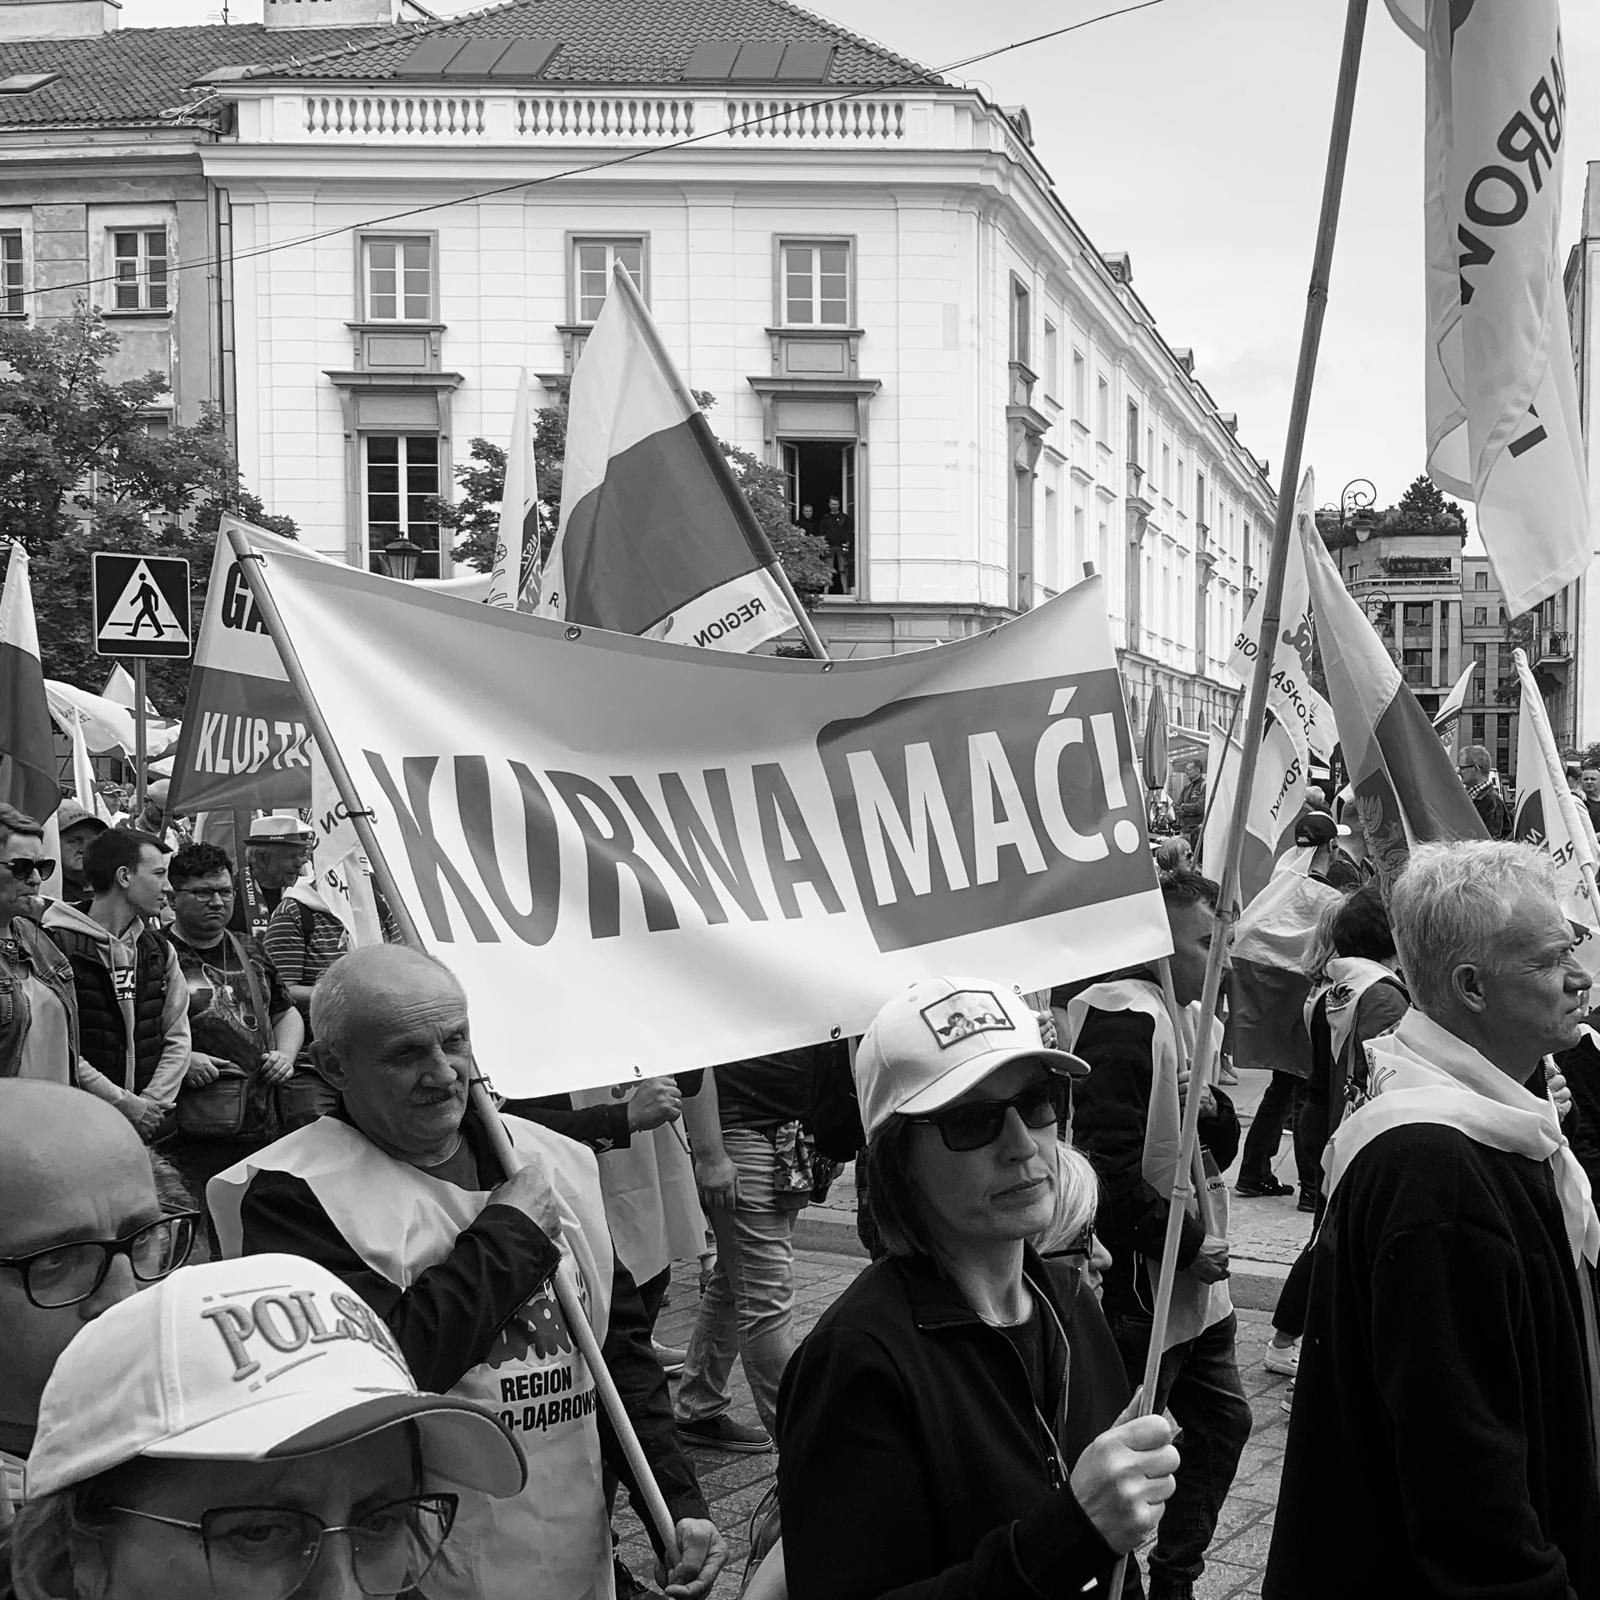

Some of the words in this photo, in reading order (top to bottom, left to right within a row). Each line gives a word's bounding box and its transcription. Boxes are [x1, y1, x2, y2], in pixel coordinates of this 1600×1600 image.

[194, 711, 270, 775] KLUB
[362, 749, 847, 947] KURWA
[846, 686, 1140, 906] MAĆ!
[494, 1387, 596, 1432] O-DĄBROW
[501, 1366, 572, 1403] REGION
